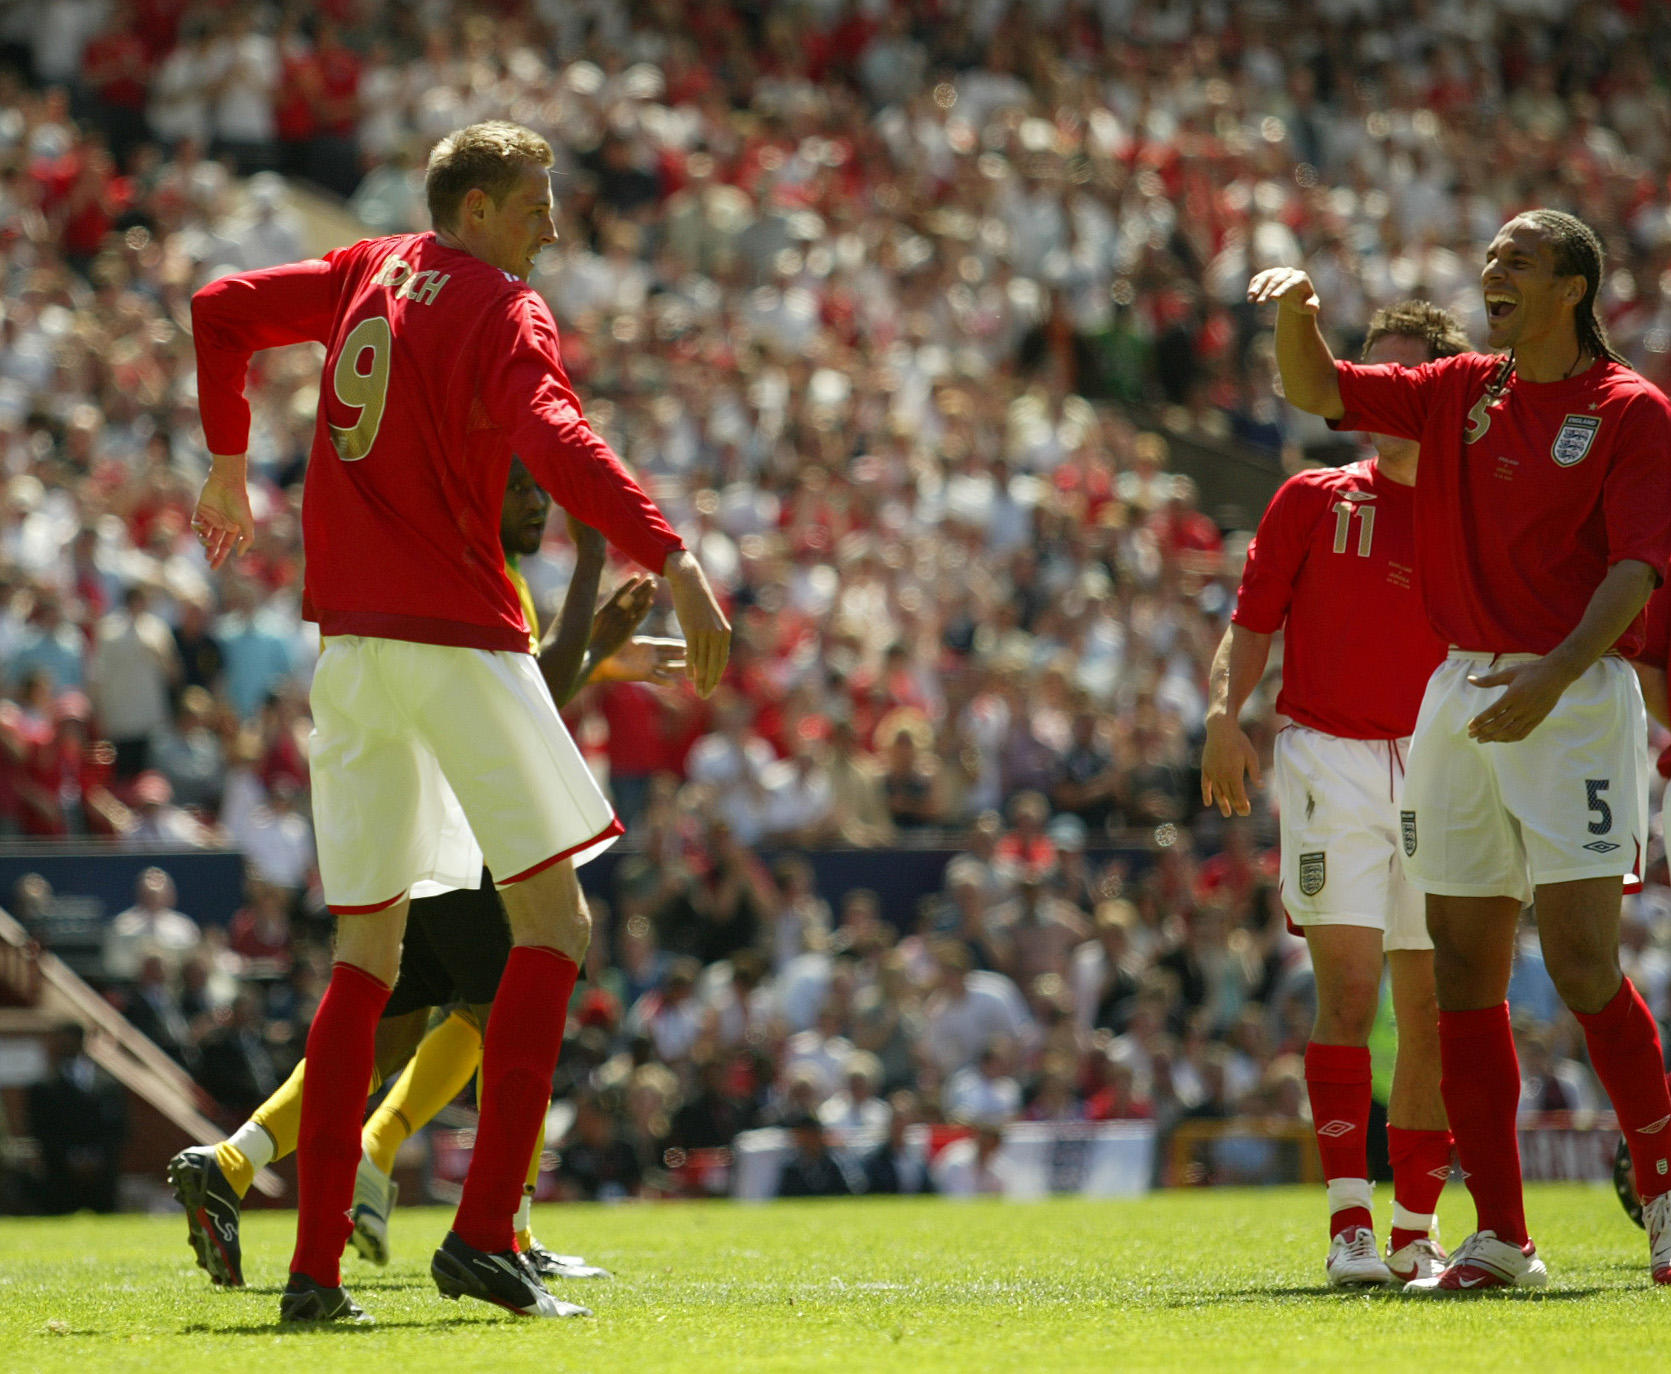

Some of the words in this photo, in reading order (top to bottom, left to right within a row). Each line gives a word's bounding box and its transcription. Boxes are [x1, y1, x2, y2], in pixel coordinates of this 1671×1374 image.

[328, 316, 391, 461] 9
[1463, 393, 1501, 445] 5
[1332, 501, 1376, 558] 11
[1584, 779, 1612, 835] 5
